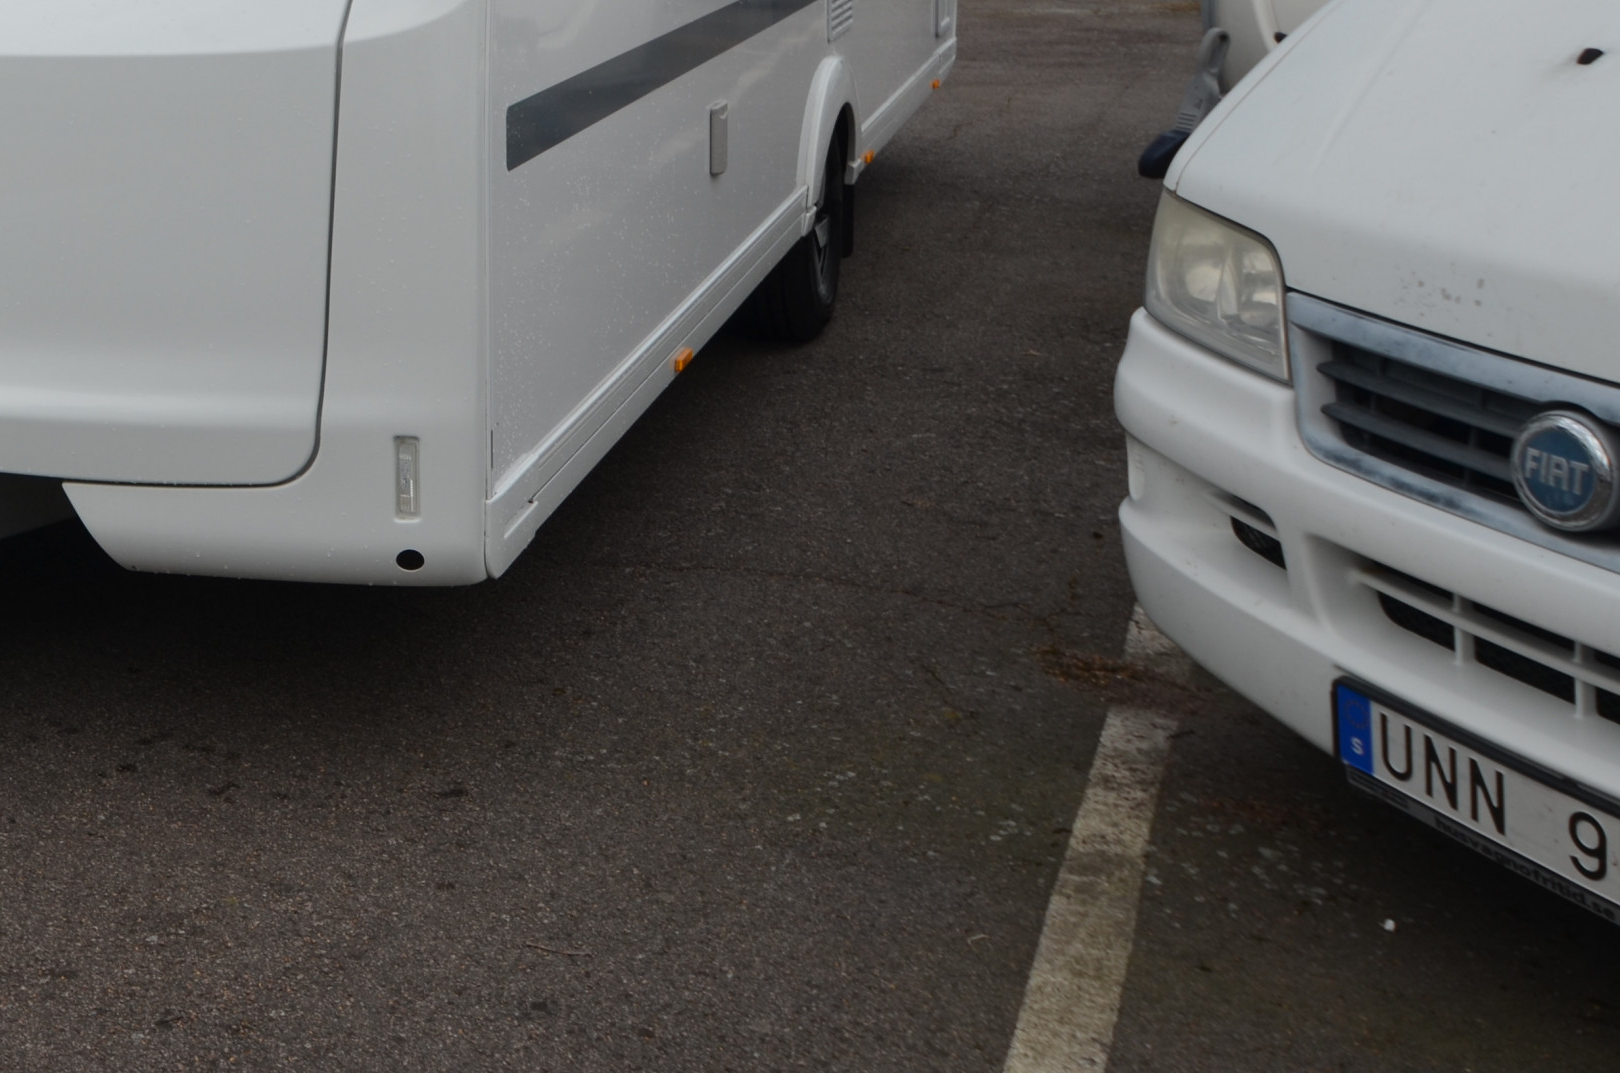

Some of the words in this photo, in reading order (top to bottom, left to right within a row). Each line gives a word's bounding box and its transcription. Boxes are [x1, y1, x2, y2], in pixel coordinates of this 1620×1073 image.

[1525, 446, 1590, 497] FIAT
[1350, 736, 1365, 756] S
[1381, 712, 1506, 837] UNN
[1568, 810, 1608, 882] 9
